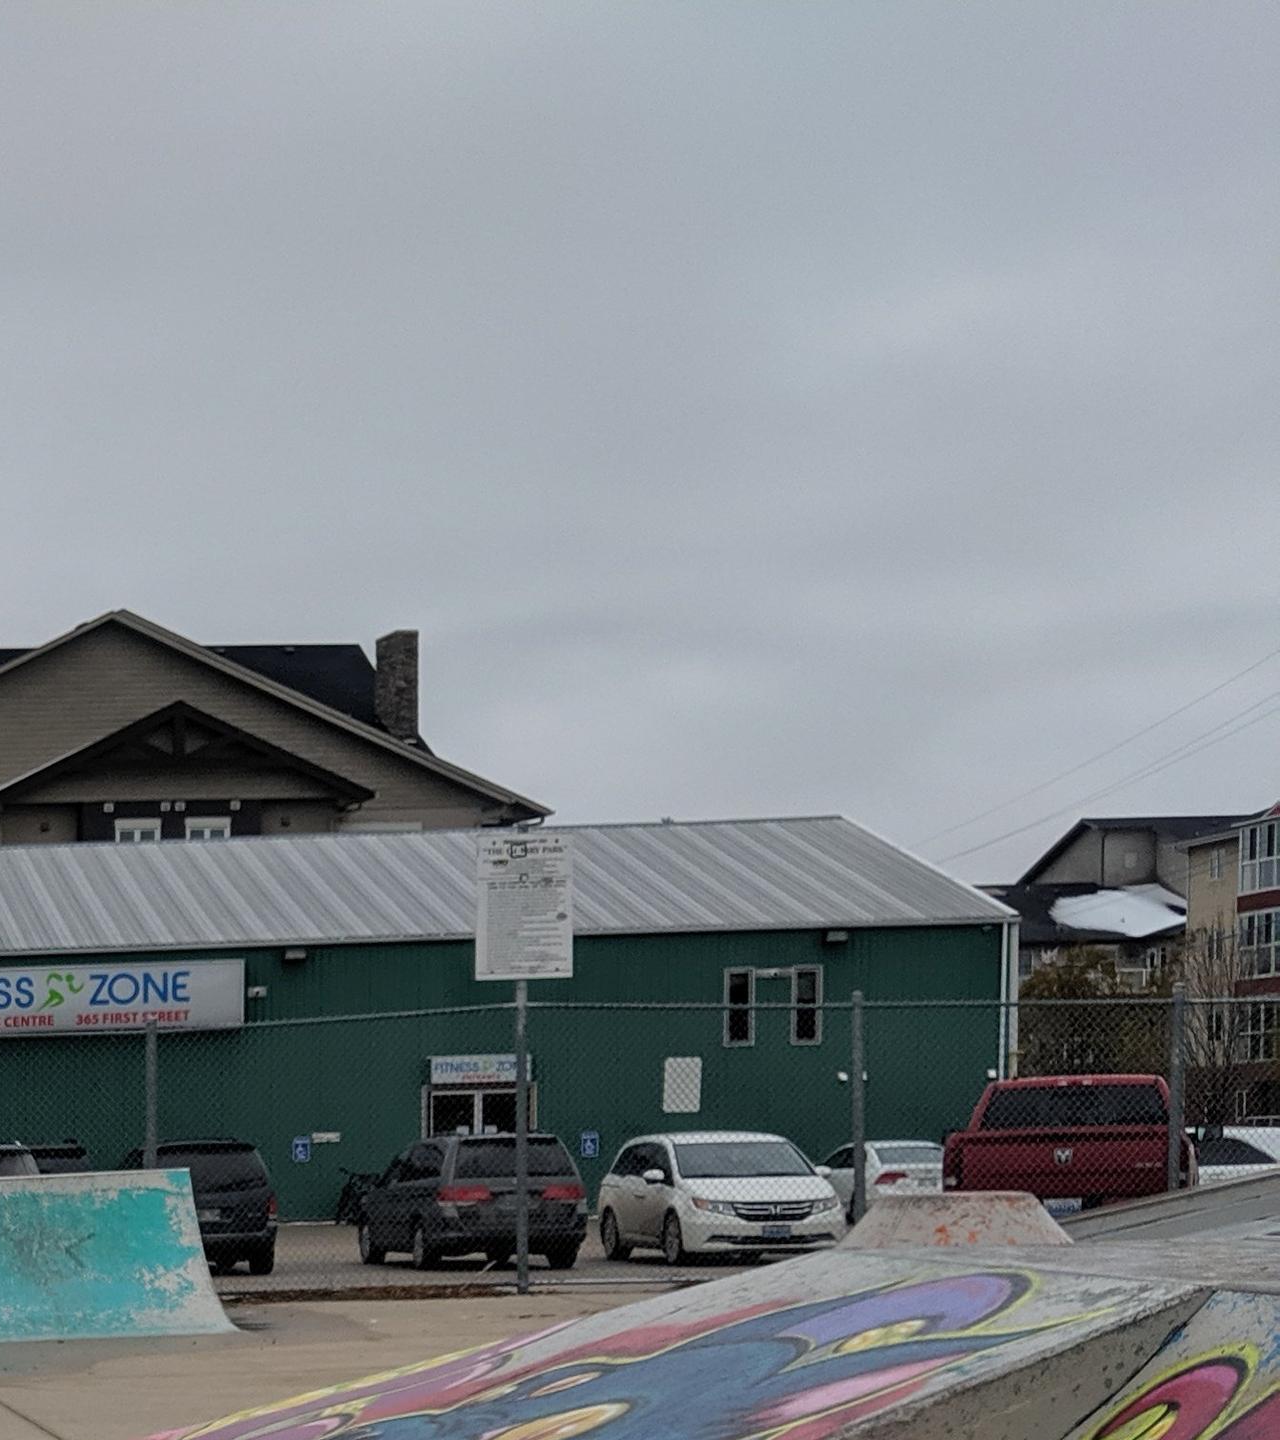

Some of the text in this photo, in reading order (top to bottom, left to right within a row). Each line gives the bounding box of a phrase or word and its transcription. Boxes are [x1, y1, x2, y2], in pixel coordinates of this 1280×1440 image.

[89, 971, 190, 1006] ZONE
[4, 1015, 55, 1029] CENTRE
[76, 1013, 99, 1025] 365
[102, 1012, 138, 1024] FIRST
[434, 1061, 480, 1073] FITNESS
